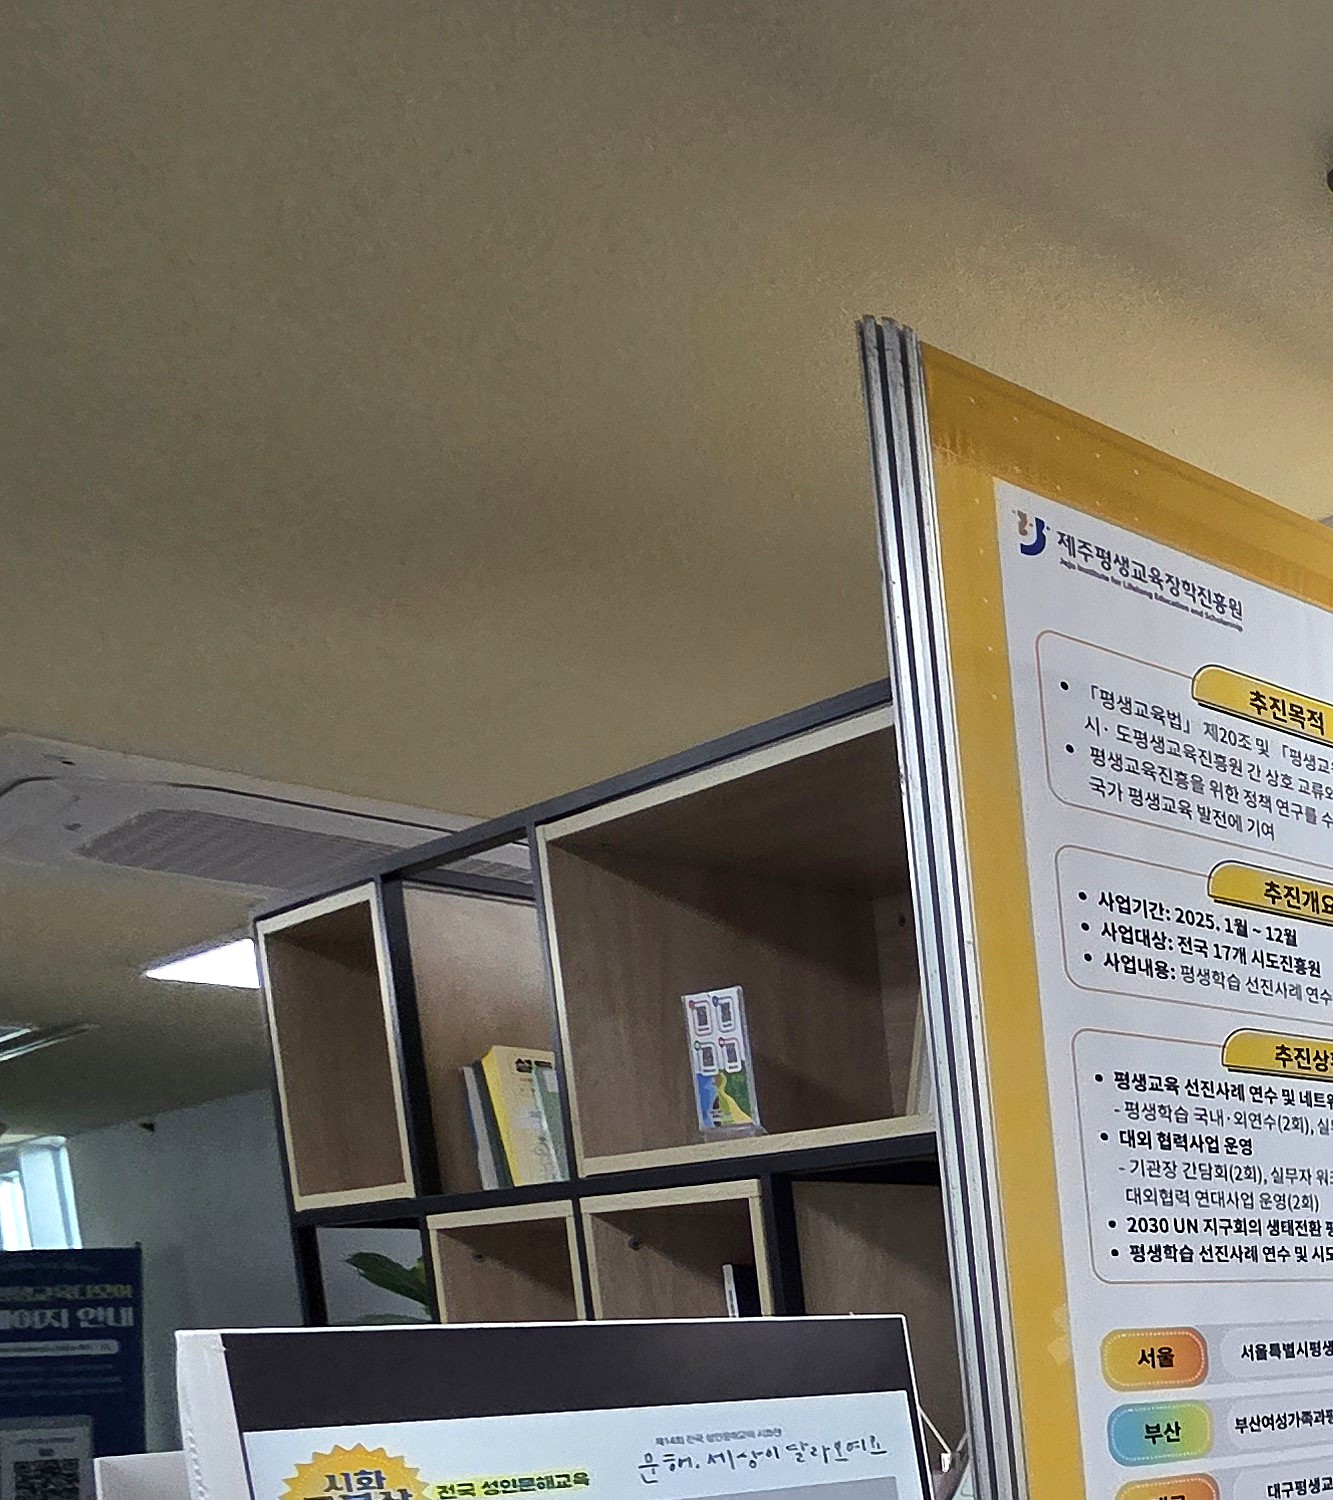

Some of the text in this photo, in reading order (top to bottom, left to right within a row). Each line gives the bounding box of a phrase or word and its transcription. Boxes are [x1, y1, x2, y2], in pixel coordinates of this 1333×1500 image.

[1056, 531, 1242, 621] 제주평생교육장학진흥원
[1091, 685, 1190, 734] 「평생교육법」
[1203, 722, 1252, 751] 제20조
[1255, 738, 1270, 758] 및
[1249, 690, 1324, 736] 추진목적
[1089, 776, 1274, 841] 국가 평생교육 발전에 기여
[1098, 891, 1170, 921] 사업기간:
[1174, 907, 1220, 931] 2025.
[1224, 918, 1248, 938] 1월
[1265, 926, 1297, 947] 12월
[1119, 1129, 1252, 1156] 대외 협력사업 운영
[1126, 1217, 1168, 1233] 2030
[1173, 1217, 1198, 1234] UN
[1203, 1217, 1262, 1237] 지구회의
[1266, 1219, 1322, 1237] 생태전환
[76, 1306, 135, 1328] 안내
[1138, 1347, 1174, 1369] 서울
[1144, 1421, 1181, 1445] 부산
[323, 1469, 386, 1492] 시화
[436, 1472, 590, 1500] 전국 성인문해교육
